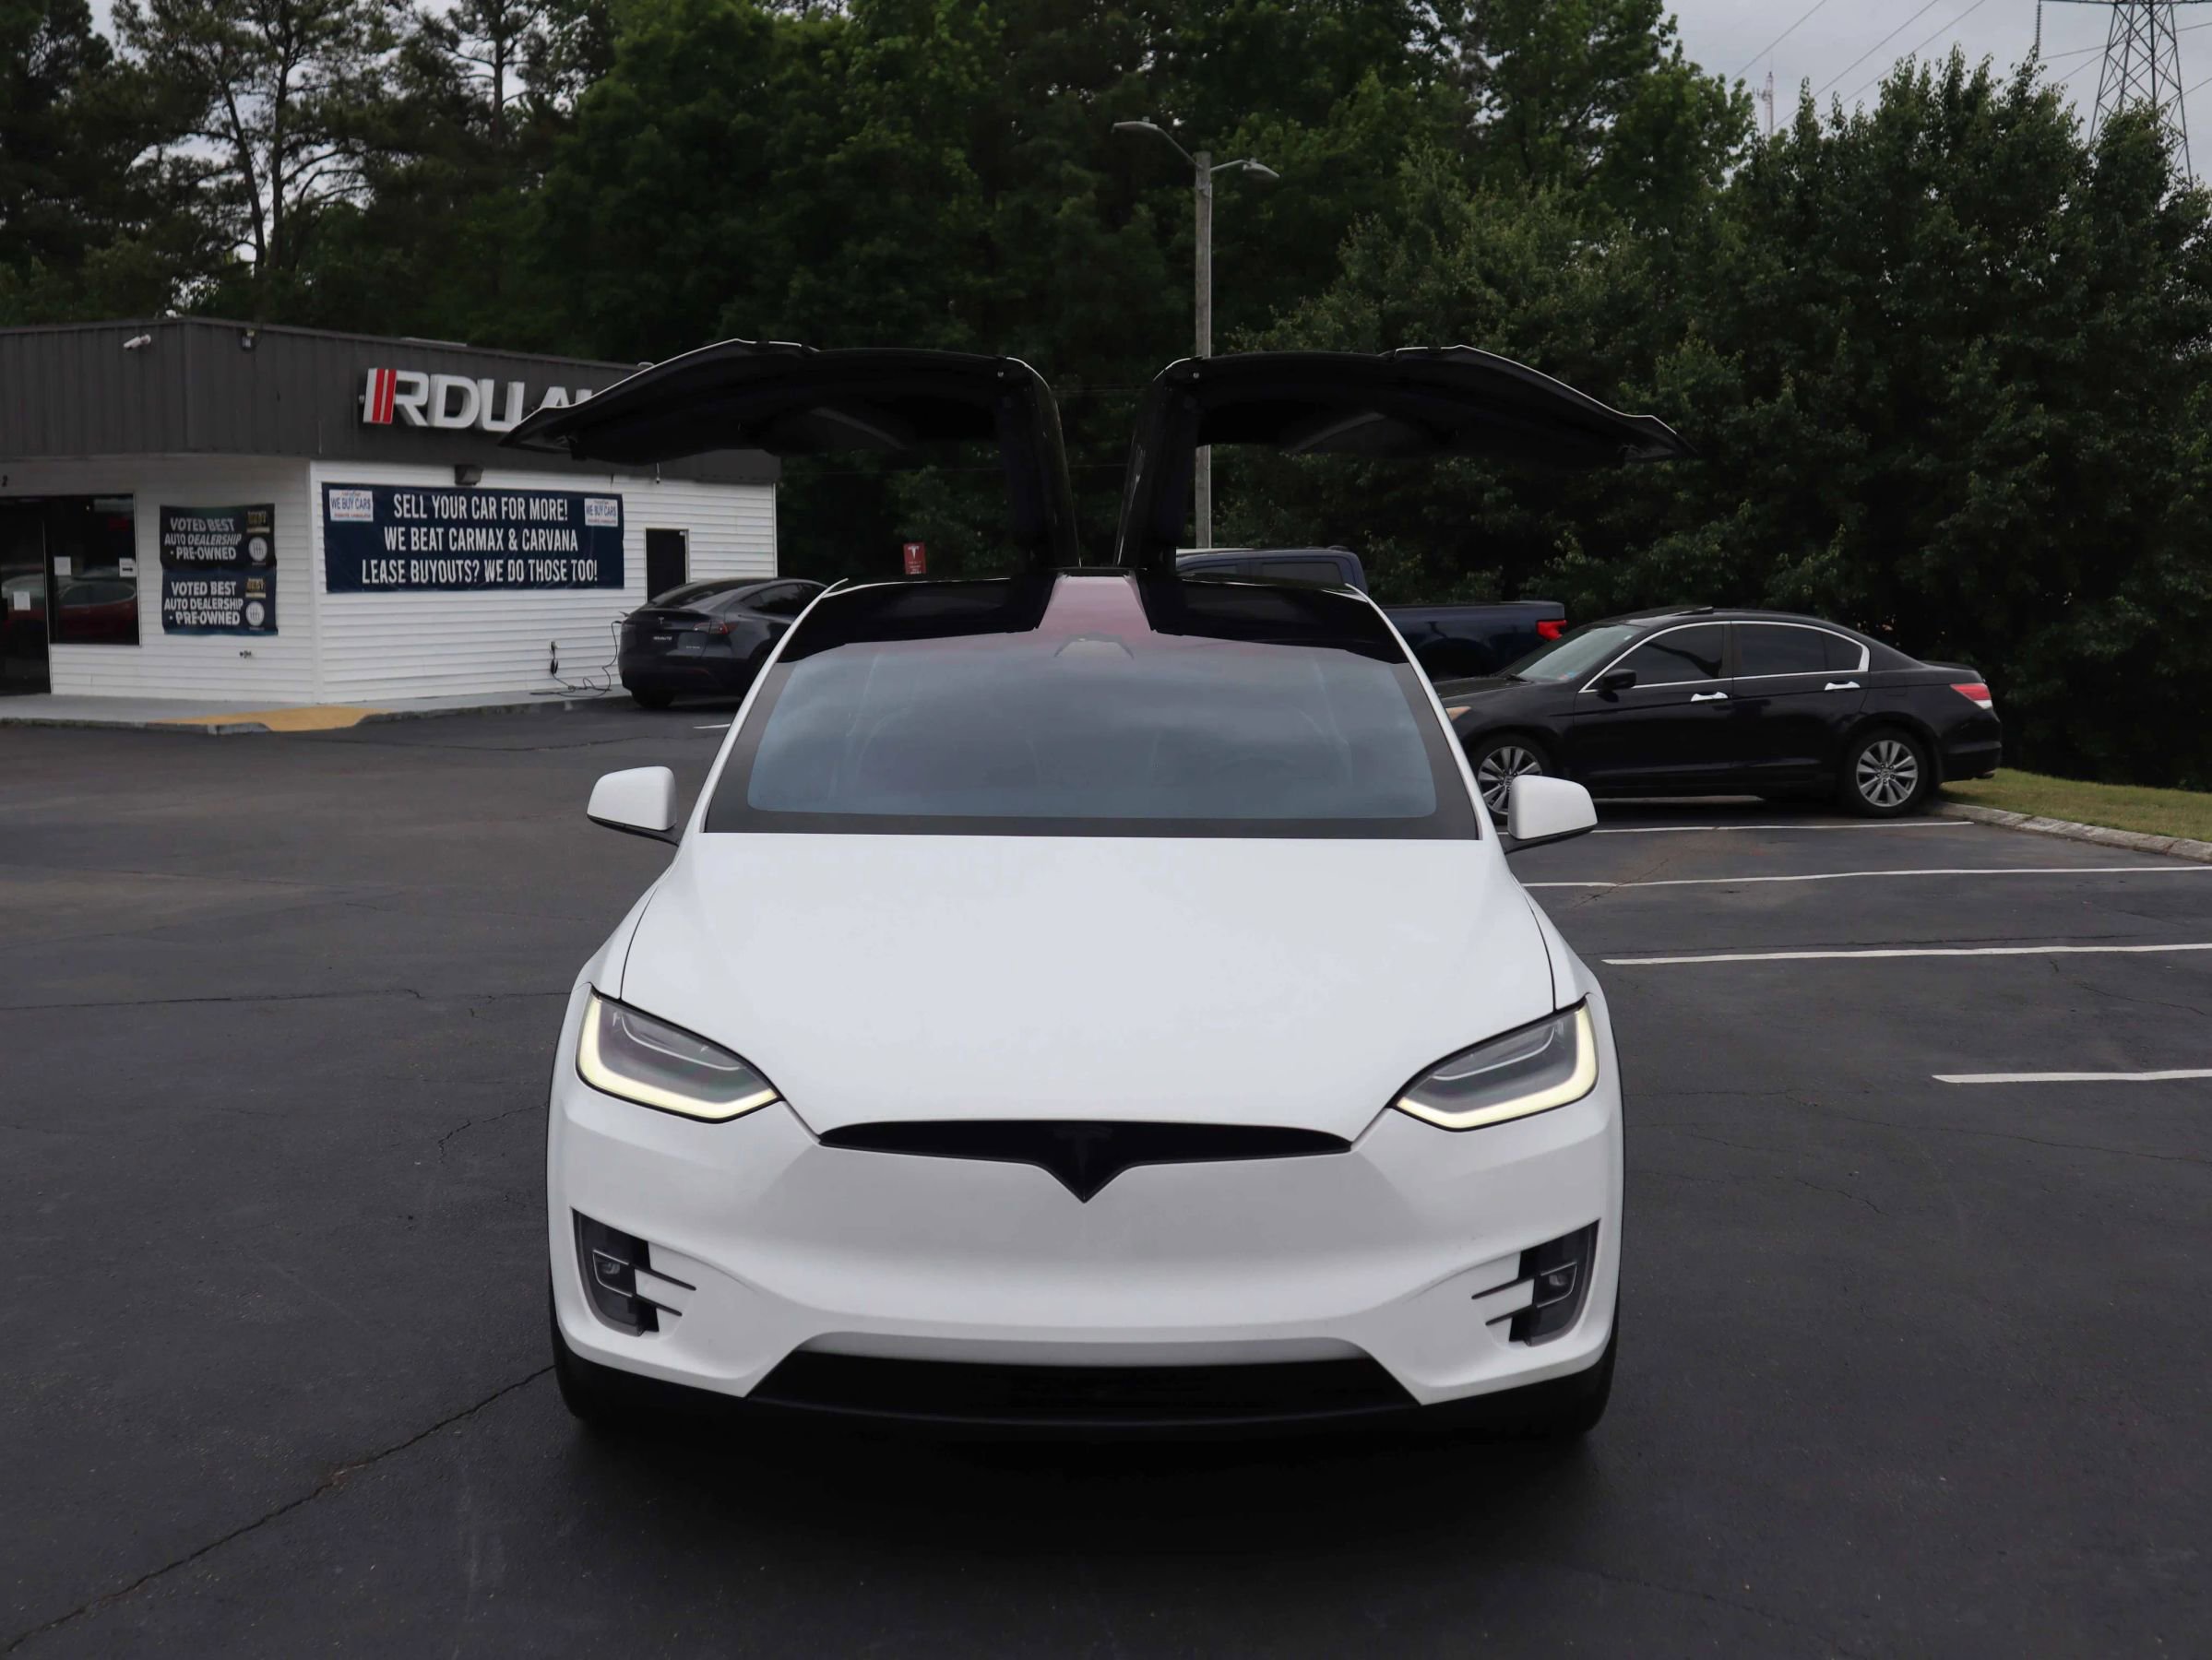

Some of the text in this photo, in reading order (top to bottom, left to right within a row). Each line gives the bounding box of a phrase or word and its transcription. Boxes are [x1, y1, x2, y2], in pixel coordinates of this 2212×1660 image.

[363, 368, 525, 433] RDU
[394, 494, 568, 522] SELL YOUR CAR FOR MORE!
[170, 518, 234, 532] VOTED BEST
[164, 533, 242, 545] AUTO DEALERSHIP
[385, 527, 578, 551] WE BEAT CARMAX & CARVANA
[176, 547, 237, 561] PRE-OWNED
[362, 559, 598, 584] LEASE BUYOUTS? WE DO THOSE TOO!
[172, 581, 236, 596] VOTED BEST
[164, 599, 244, 611] AUTO DEALERSHIP
[175, 611, 240, 625] PRE-OWNED
